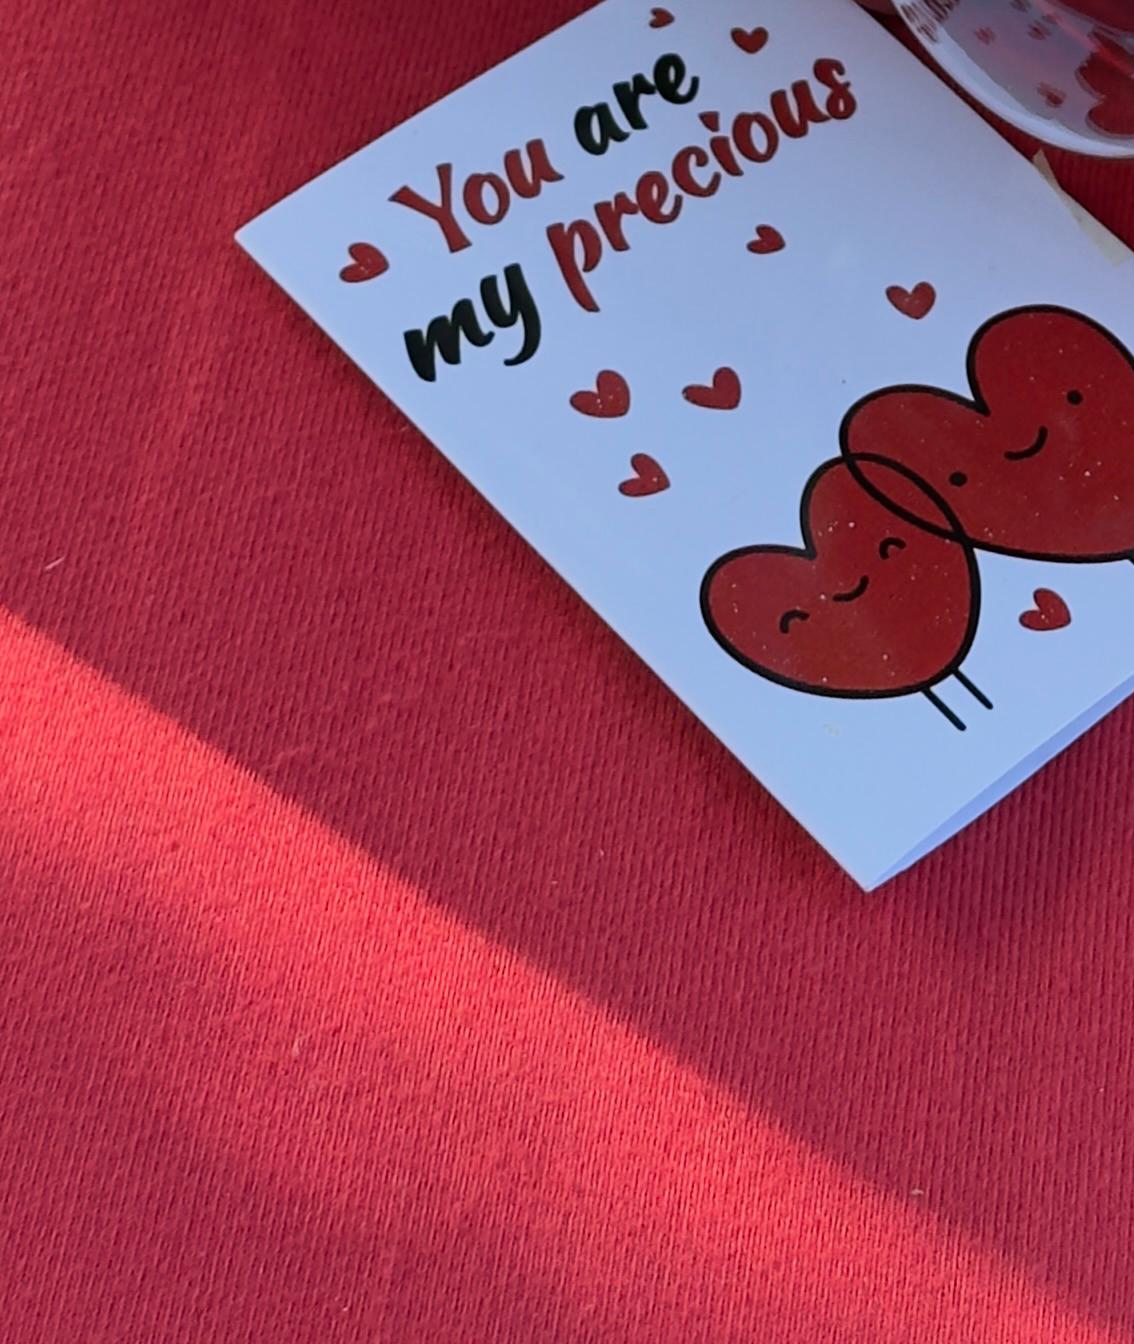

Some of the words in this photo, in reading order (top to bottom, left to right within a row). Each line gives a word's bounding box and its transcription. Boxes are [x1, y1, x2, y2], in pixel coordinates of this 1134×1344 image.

[388, 138, 564, 253] You
[574, 53, 700, 155] are
[403, 263, 541, 382] my
[546, 58, 857, 312] precious
